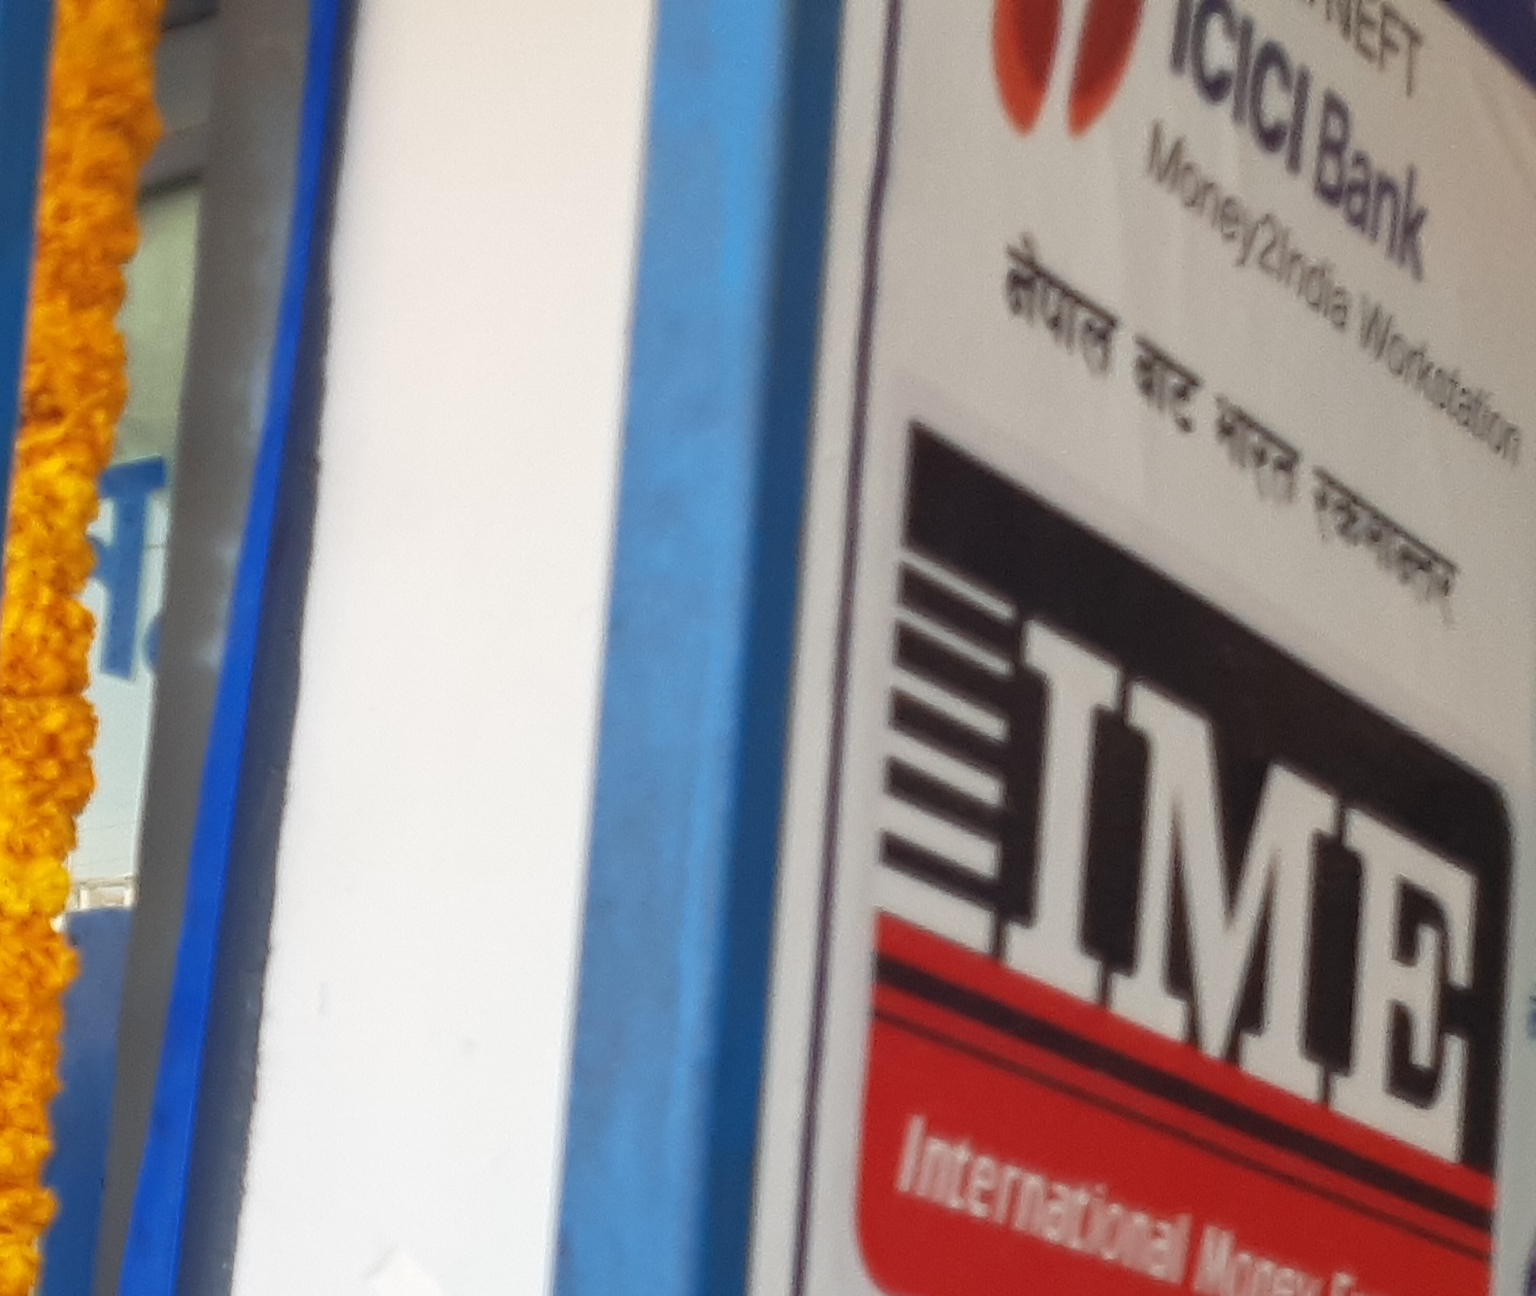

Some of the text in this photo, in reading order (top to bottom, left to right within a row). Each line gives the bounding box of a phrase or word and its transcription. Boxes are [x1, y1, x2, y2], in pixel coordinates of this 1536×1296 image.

[1147, 119, 1349, 333] Money2India
[1169, 0, 1428, 283] ICICI Bank
[1002, 617, 1479, 1164] IME
[895, 1112, 1193, 1287] International
